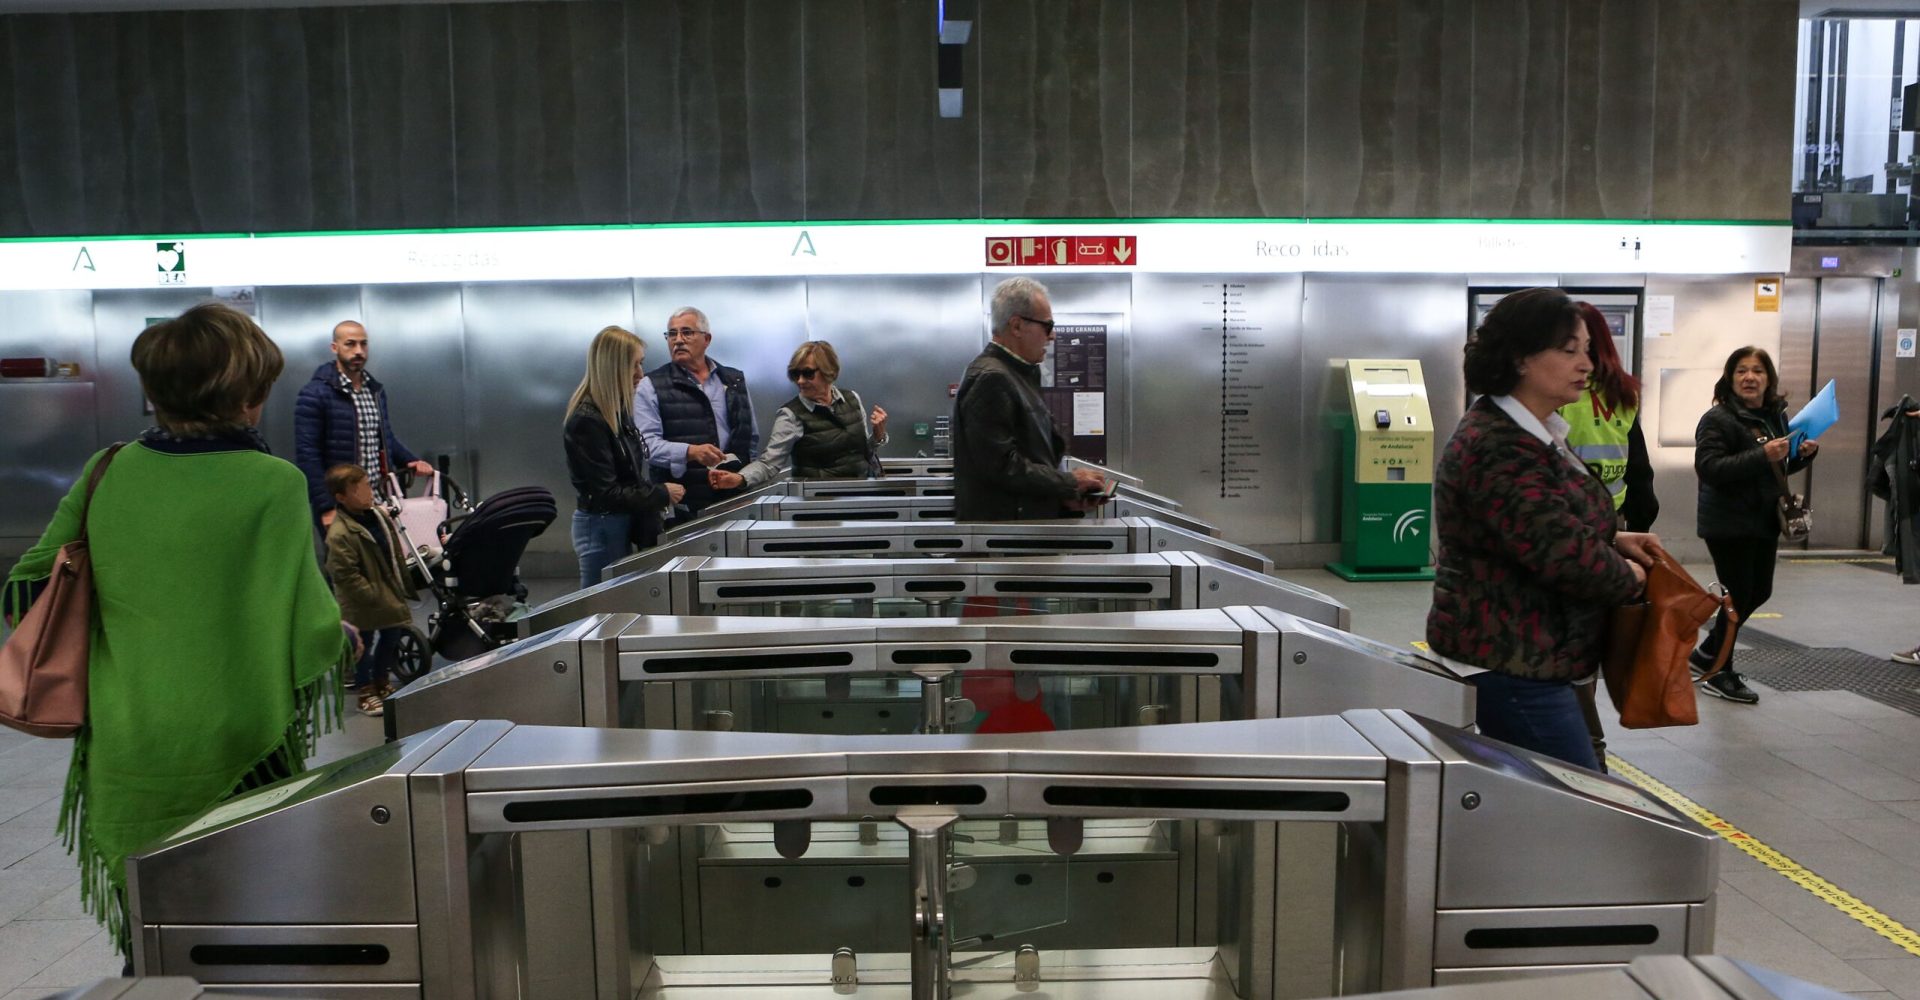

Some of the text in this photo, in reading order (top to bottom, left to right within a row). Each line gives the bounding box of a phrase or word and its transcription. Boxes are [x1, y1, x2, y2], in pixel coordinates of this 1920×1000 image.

[1255, 239, 1350, 258] Recoidas
[407, 248, 501, 271] Recogdas
[1802, 876, 1853, 907] DISTANCIA
[1851, 906, 1868, 915] LA
